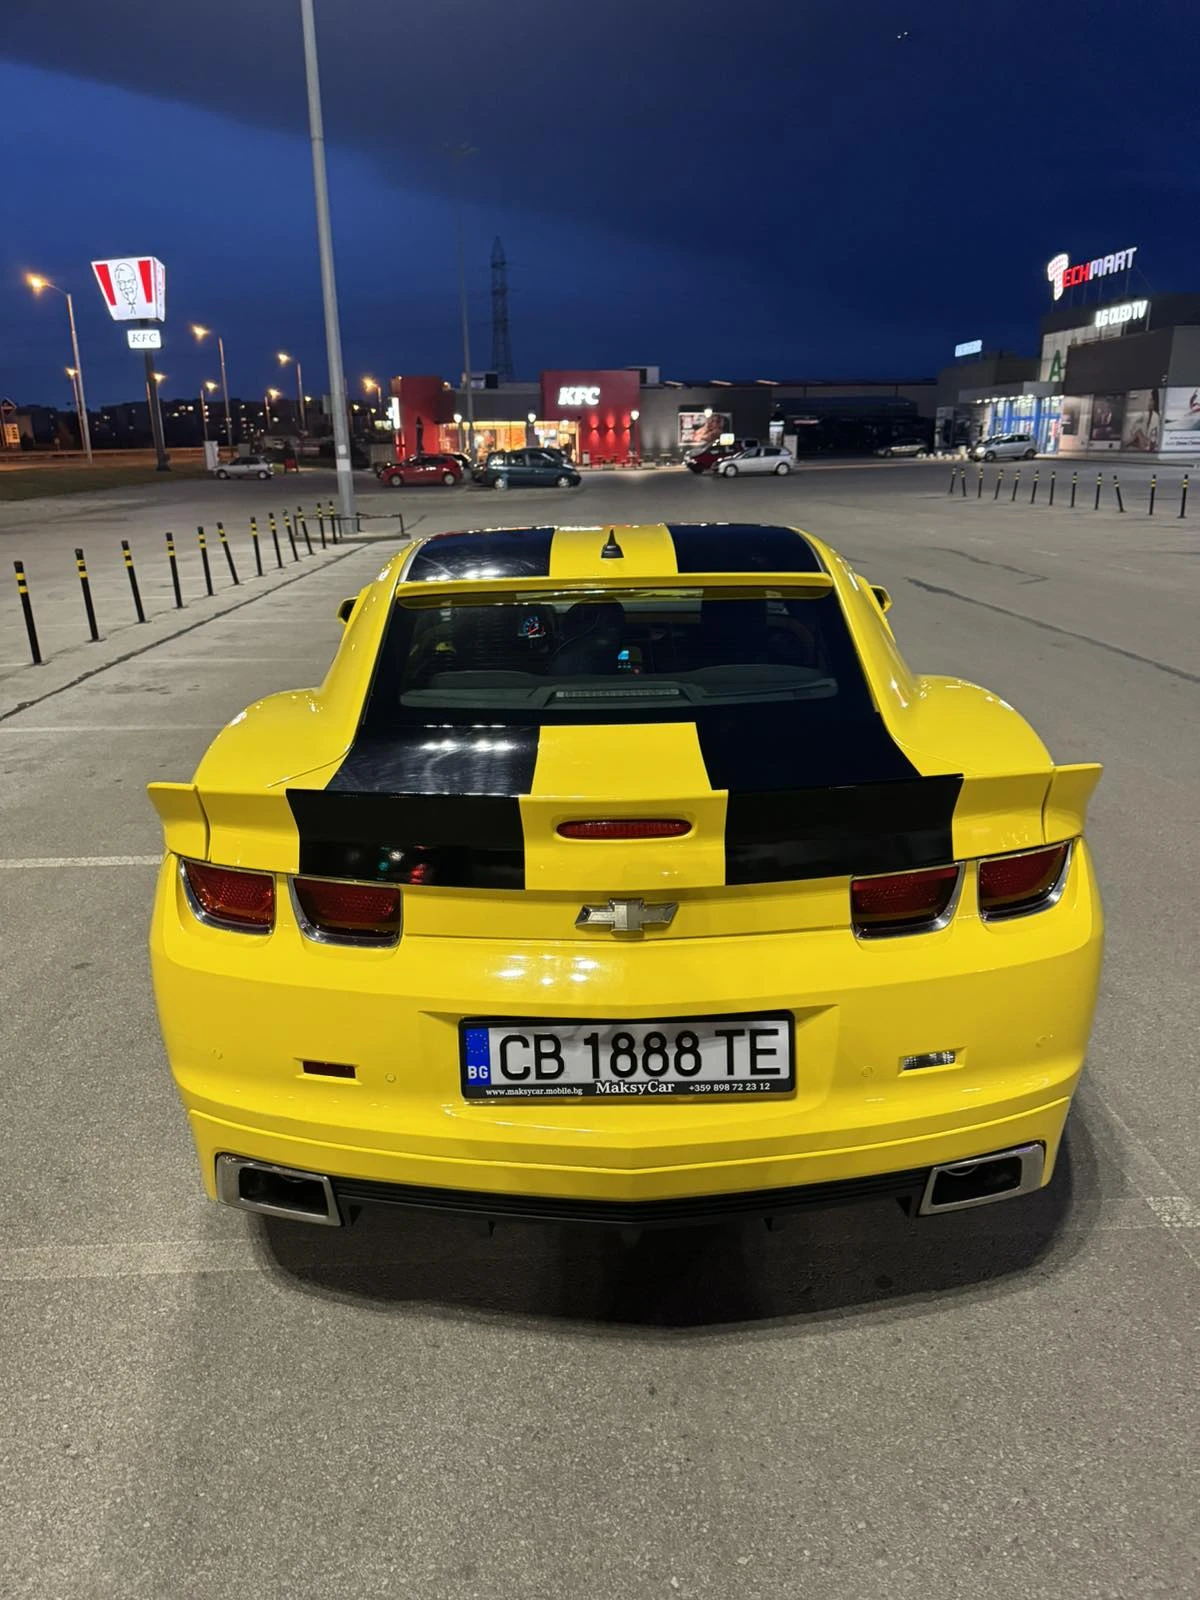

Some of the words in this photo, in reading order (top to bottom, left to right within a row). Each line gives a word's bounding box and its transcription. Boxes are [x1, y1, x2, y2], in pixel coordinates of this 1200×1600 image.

[1047, 247, 1138, 301] TECHMART
[1095, 309, 1109, 328] LG
[1109, 303, 1133, 325] OLED
[1132, 300, 1148, 320] TV
[131, 332, 157, 343] KFC
[557, 386, 601, 405] KFC
[500, 1033, 565, 1081] CB
[583, 1030, 702, 1079] 1888
[714, 1028, 781, 1076] TE
[467, 1065, 489, 1079] BG
[485, 1087, 583, 1097] www.maksycar.mobile.bg
[596, 1081, 675, 1095] MaksyCar
[688, 1083, 712, 1092] +359
[713, 1083, 730, 1092] 898
[732, 1083, 743, 1091] 72
[745, 1083, 757, 1091] 23
[760, 1082, 771, 1091] 12
